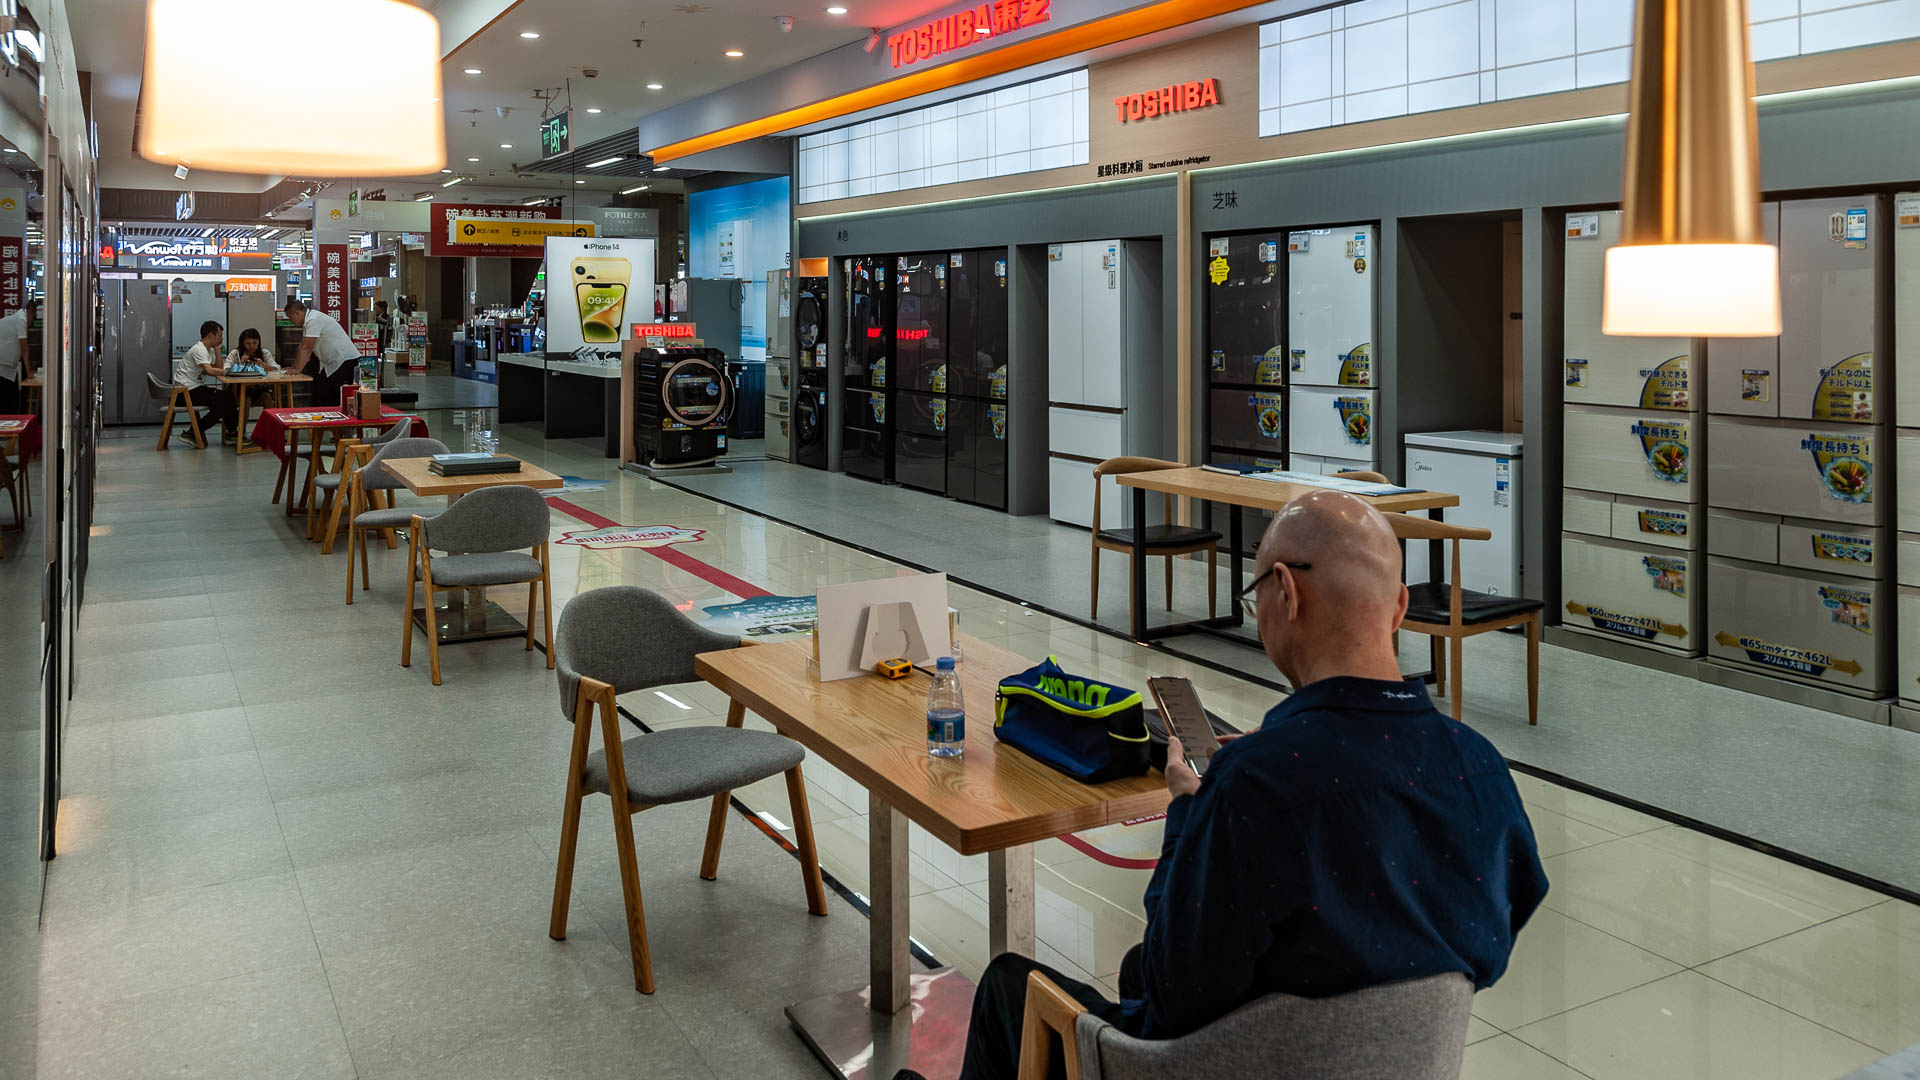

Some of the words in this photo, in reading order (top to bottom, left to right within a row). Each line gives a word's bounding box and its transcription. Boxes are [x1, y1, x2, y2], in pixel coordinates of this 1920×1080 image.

[1113, 77, 1220, 123] TOSHIBA
[1097, 159, 1144, 178] 星级料理冰箱
[1166, 158, 1184, 168] cuisine
[1212, 190, 1239, 210] 芝味
[604, 211, 632, 219] FOTILE
[589, 243, 612, 251] iPhone
[587, 296, 617, 305] 09:41
[635, 325, 695, 337] TOSHIBA
[1818, 368, 1872, 378] チルドなのに
[1828, 379, 1872, 389] チルド以上
